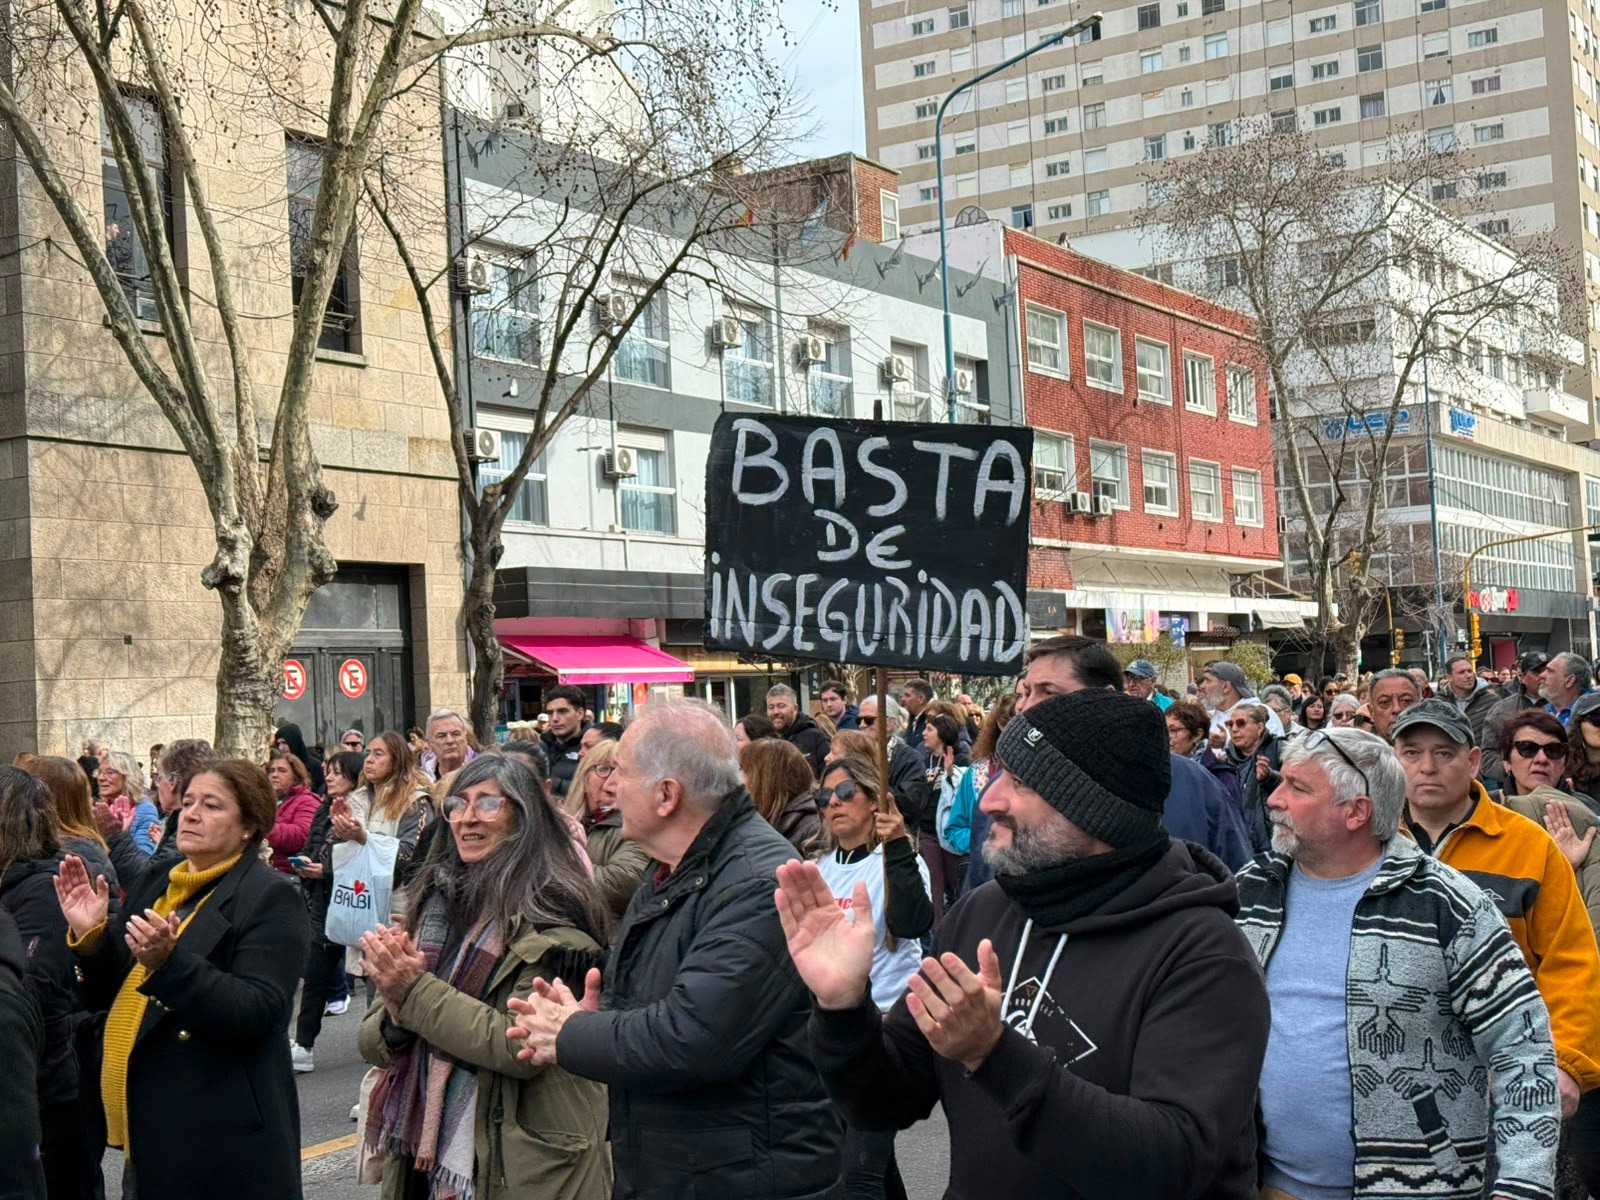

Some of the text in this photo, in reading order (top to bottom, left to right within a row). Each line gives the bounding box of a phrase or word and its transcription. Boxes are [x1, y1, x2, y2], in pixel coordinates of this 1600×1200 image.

[732, 418, 1026, 526] BASTA
[814, 509, 912, 569] DE
[333, 889, 371, 910] BALBI
